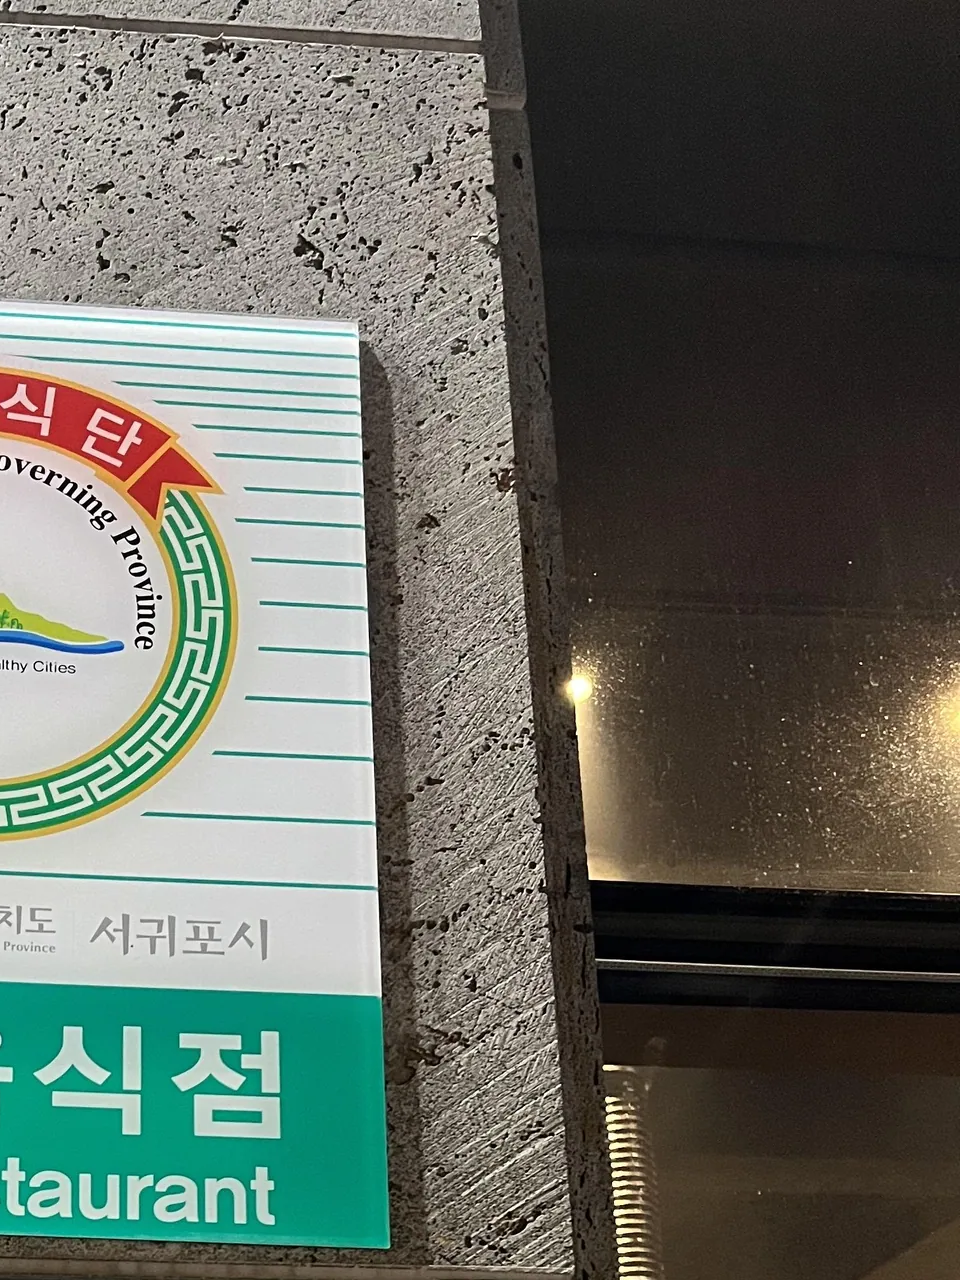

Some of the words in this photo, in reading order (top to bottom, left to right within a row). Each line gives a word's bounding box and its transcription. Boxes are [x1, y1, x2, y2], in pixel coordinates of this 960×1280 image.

[110, 525, 163, 650] Province
[33, 660, 77, 675] Cities
[3, 941, 57, 954] Province
[89, 913, 268, 961] 서귀포시
